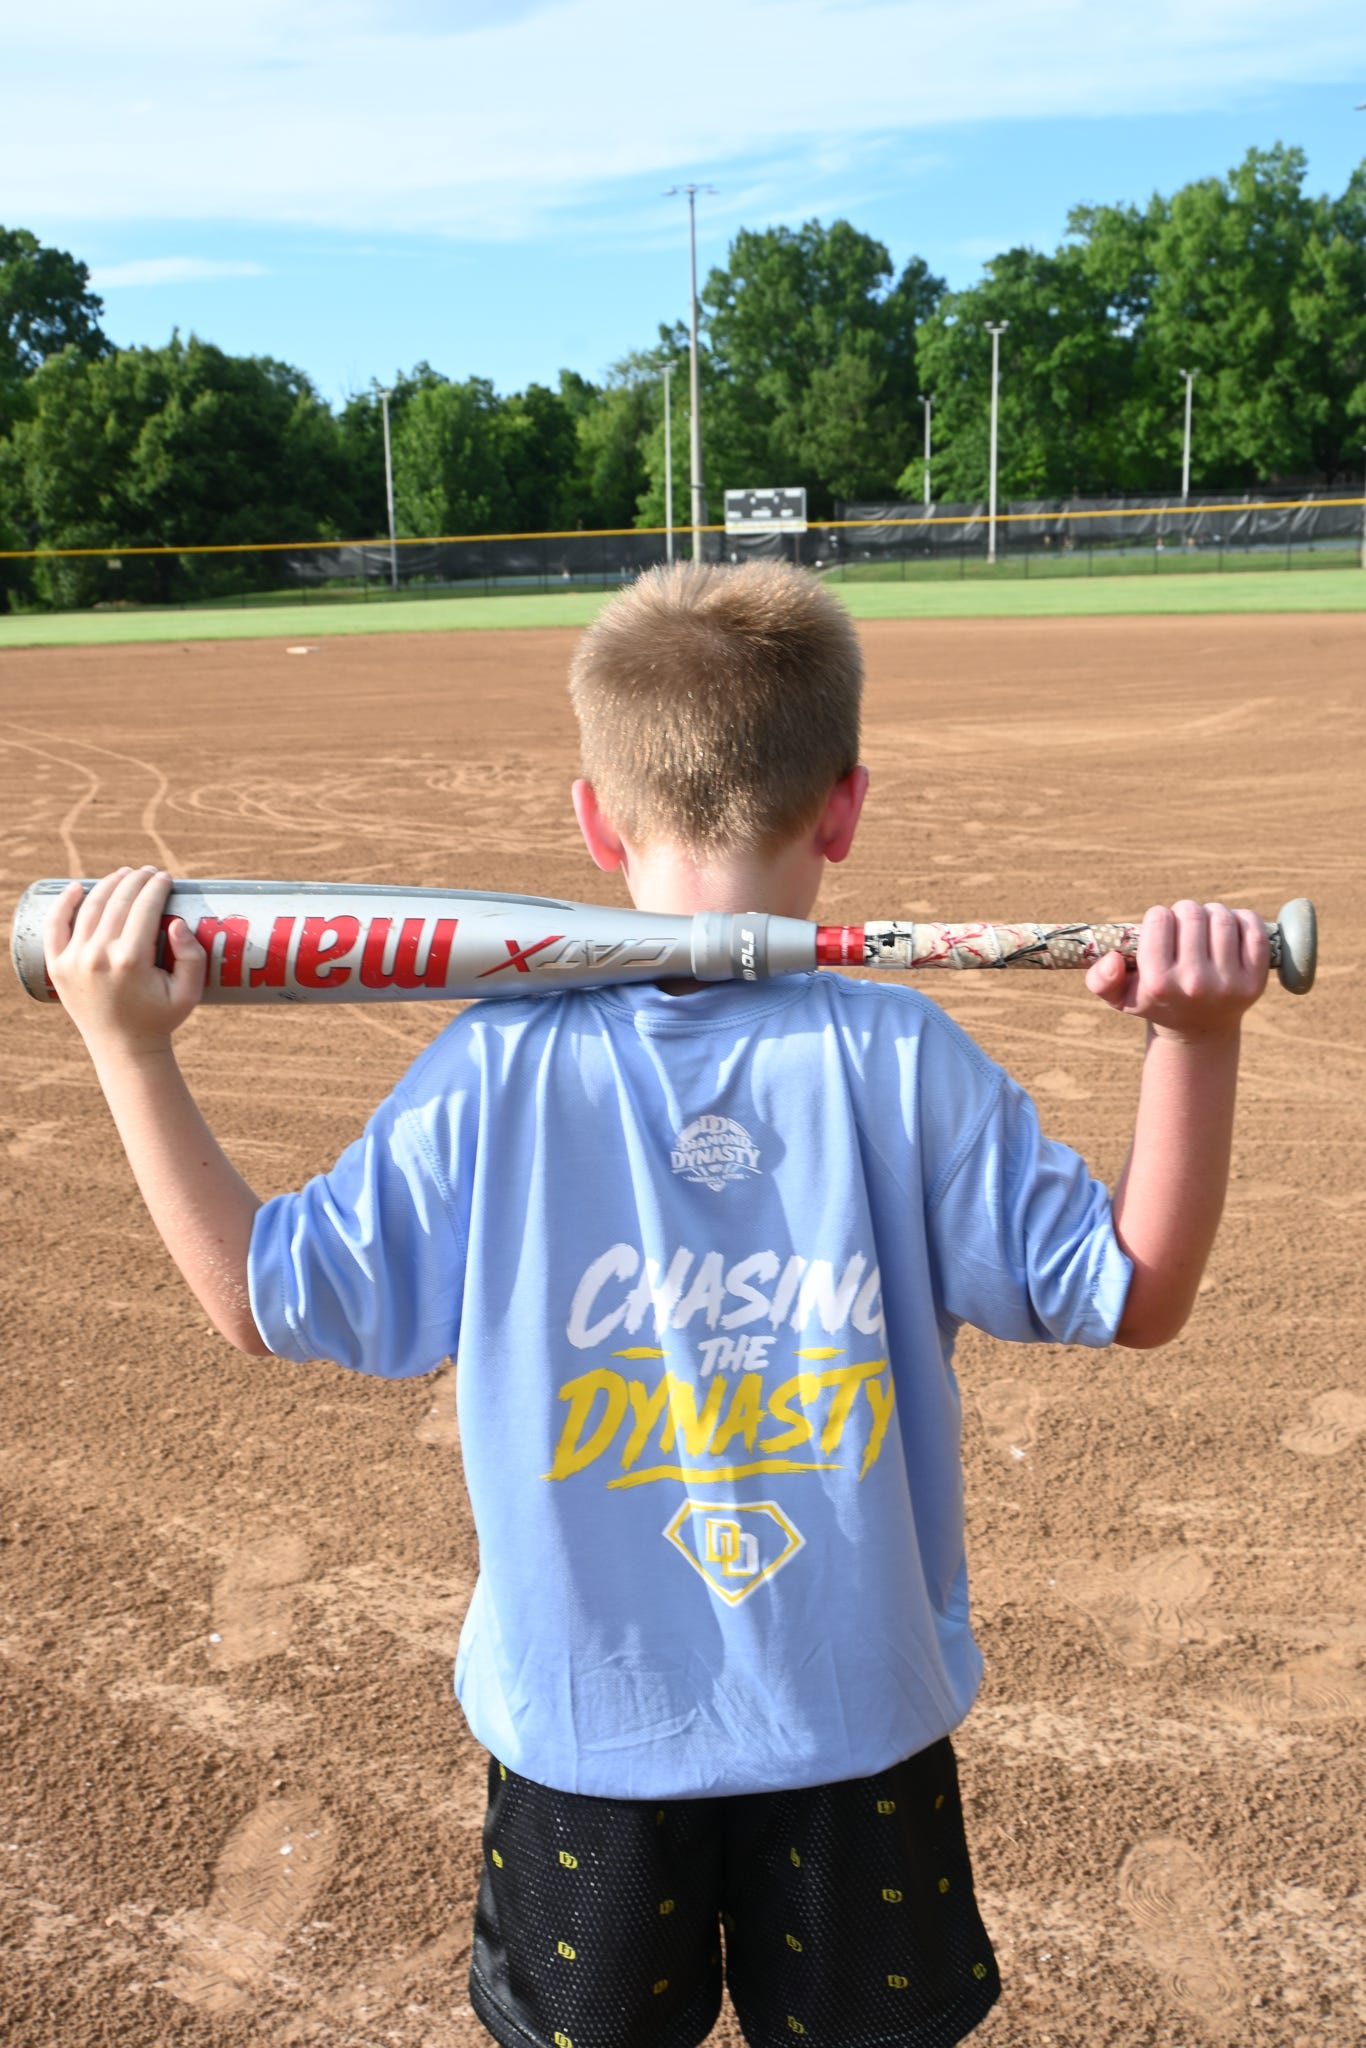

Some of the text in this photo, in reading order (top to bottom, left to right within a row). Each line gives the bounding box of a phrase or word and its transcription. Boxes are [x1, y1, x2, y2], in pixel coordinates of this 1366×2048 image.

[44, 915, 458, 999] maru
[670, 1146, 761, 1168] DYNASTY
[680, 1134, 752, 1151] DIAMOND
[697, 1335, 776, 1378] THE
[540, 1359, 894, 1483] DYNASTY
